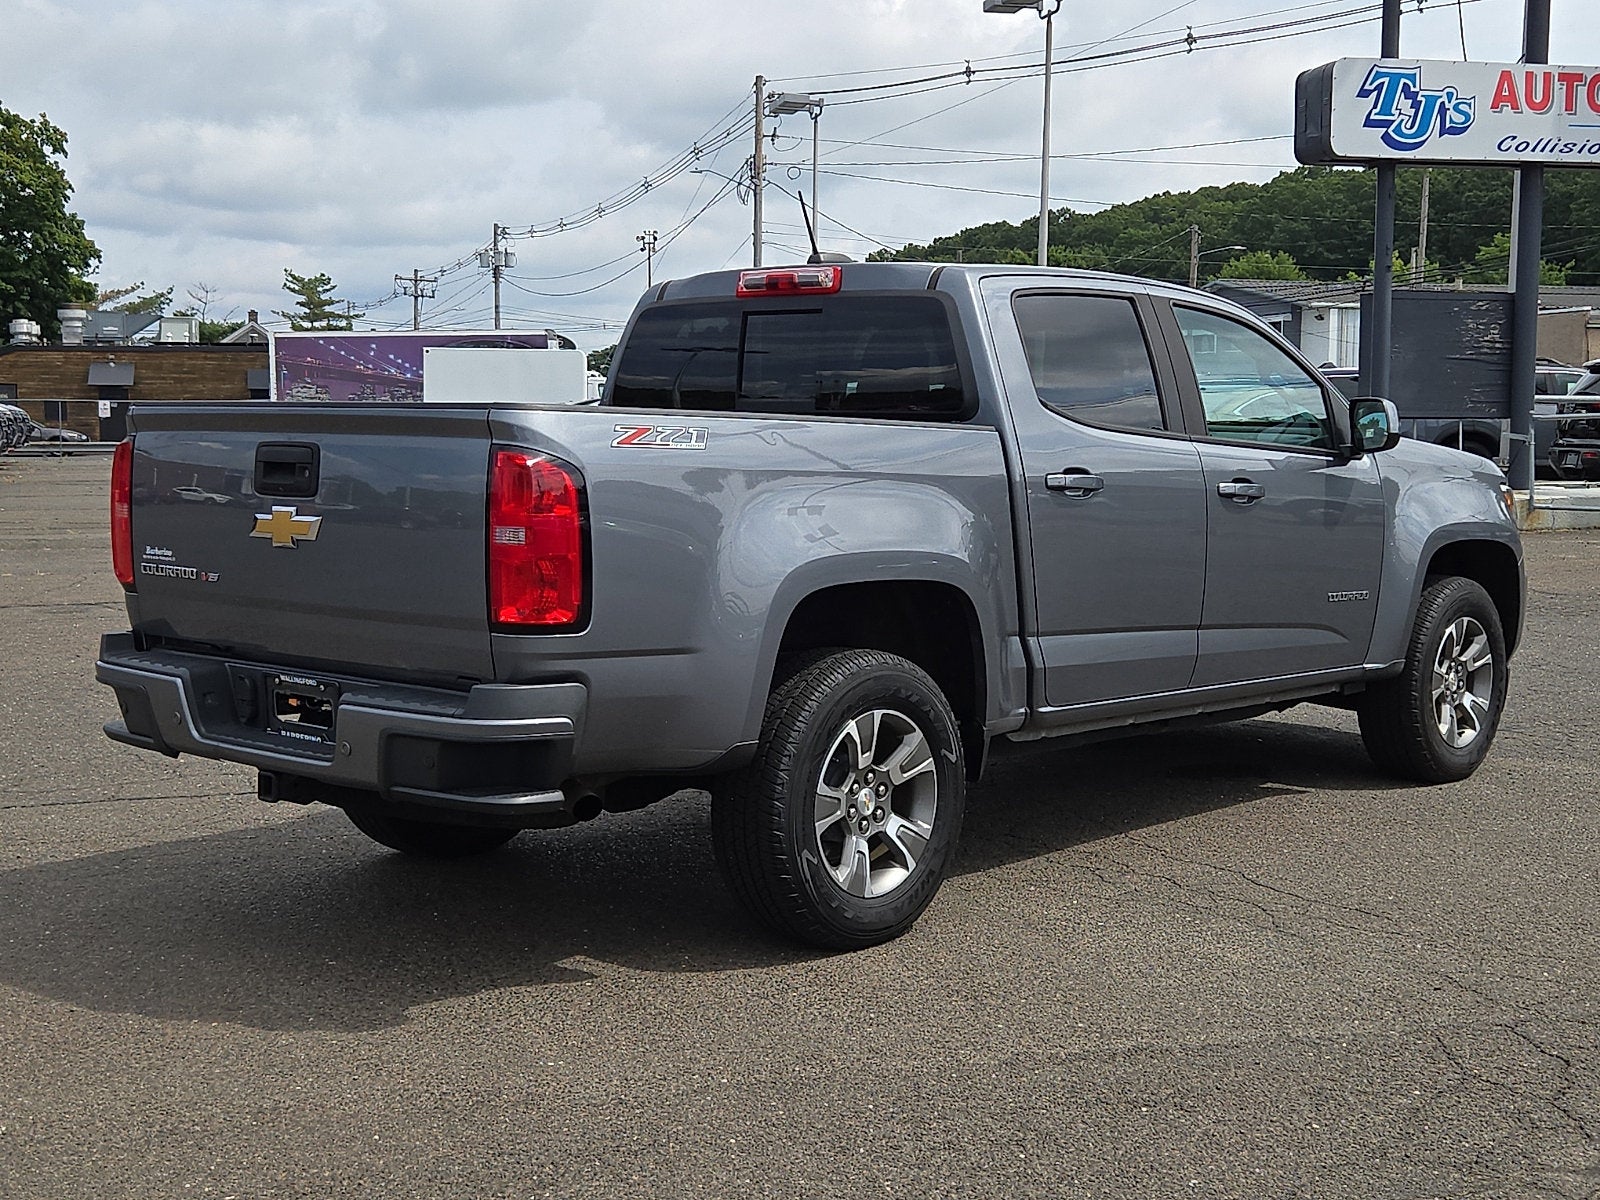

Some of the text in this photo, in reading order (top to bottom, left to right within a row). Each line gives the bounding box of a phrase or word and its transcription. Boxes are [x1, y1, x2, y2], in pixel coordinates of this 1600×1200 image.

[1357, 64, 1475, 150] TJ's
[1497, 134, 1600, 155] Collisio
[611, 424, 709, 449] Z71
[141, 562, 220, 582] COLORADO V6
[1328, 590, 1369, 602] COLORADO
